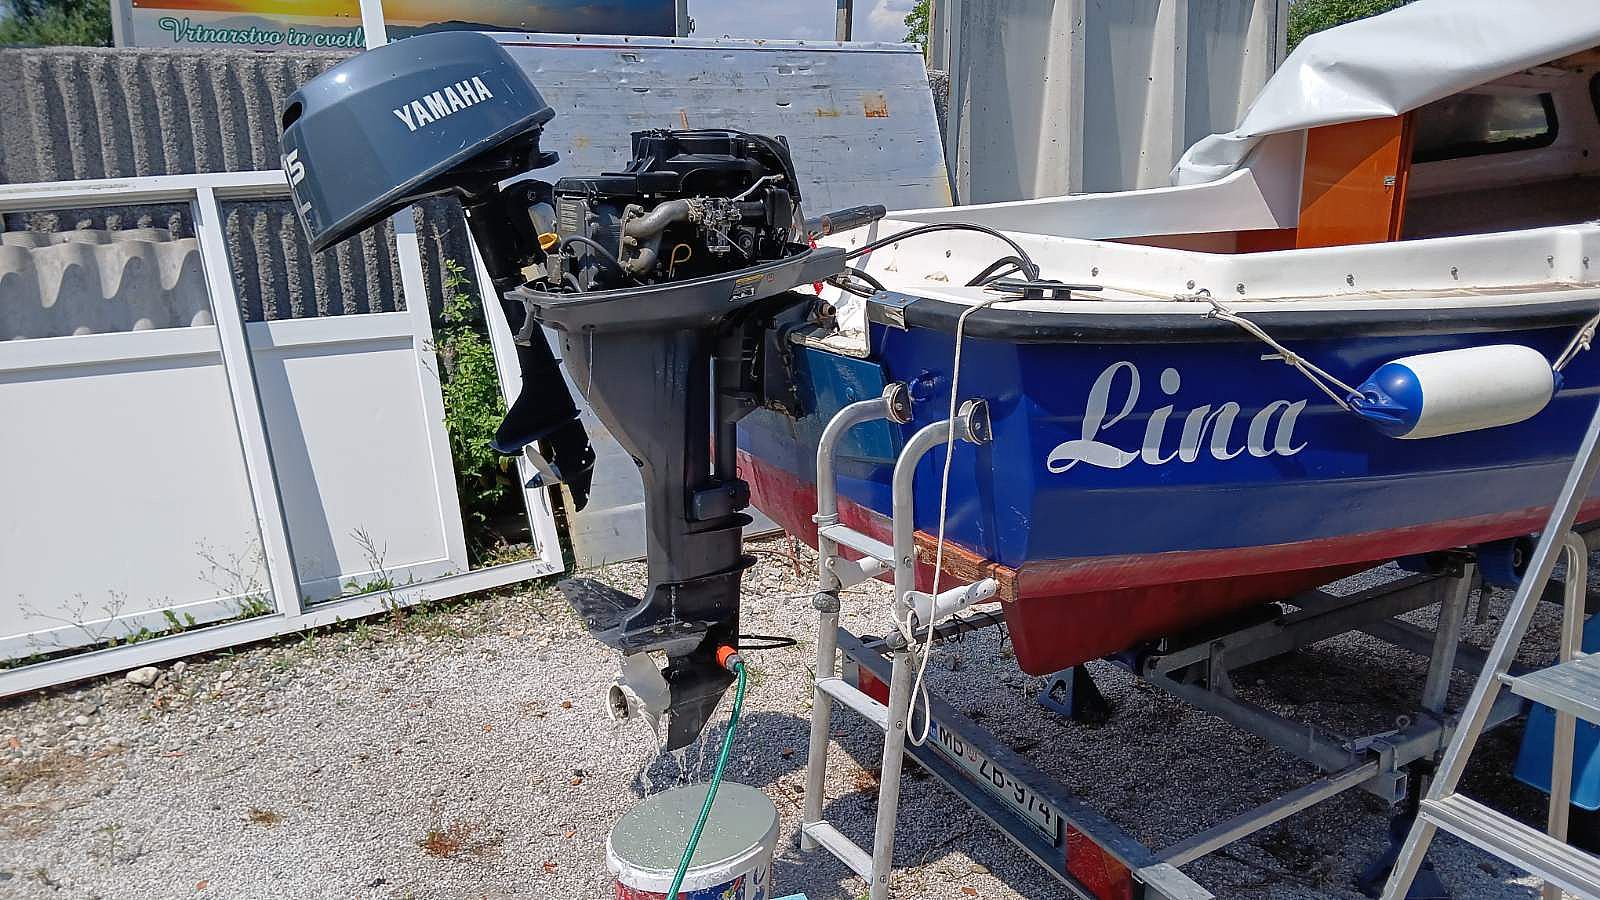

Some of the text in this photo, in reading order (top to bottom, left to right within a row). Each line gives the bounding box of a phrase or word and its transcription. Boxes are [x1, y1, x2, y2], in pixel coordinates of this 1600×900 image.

[159, 16, 285, 45] Vrtnarstvo
[287, 27, 311, 46] in
[393, 77, 494, 132] YAMAHA
[1046, 361, 1308, 474] Lina
